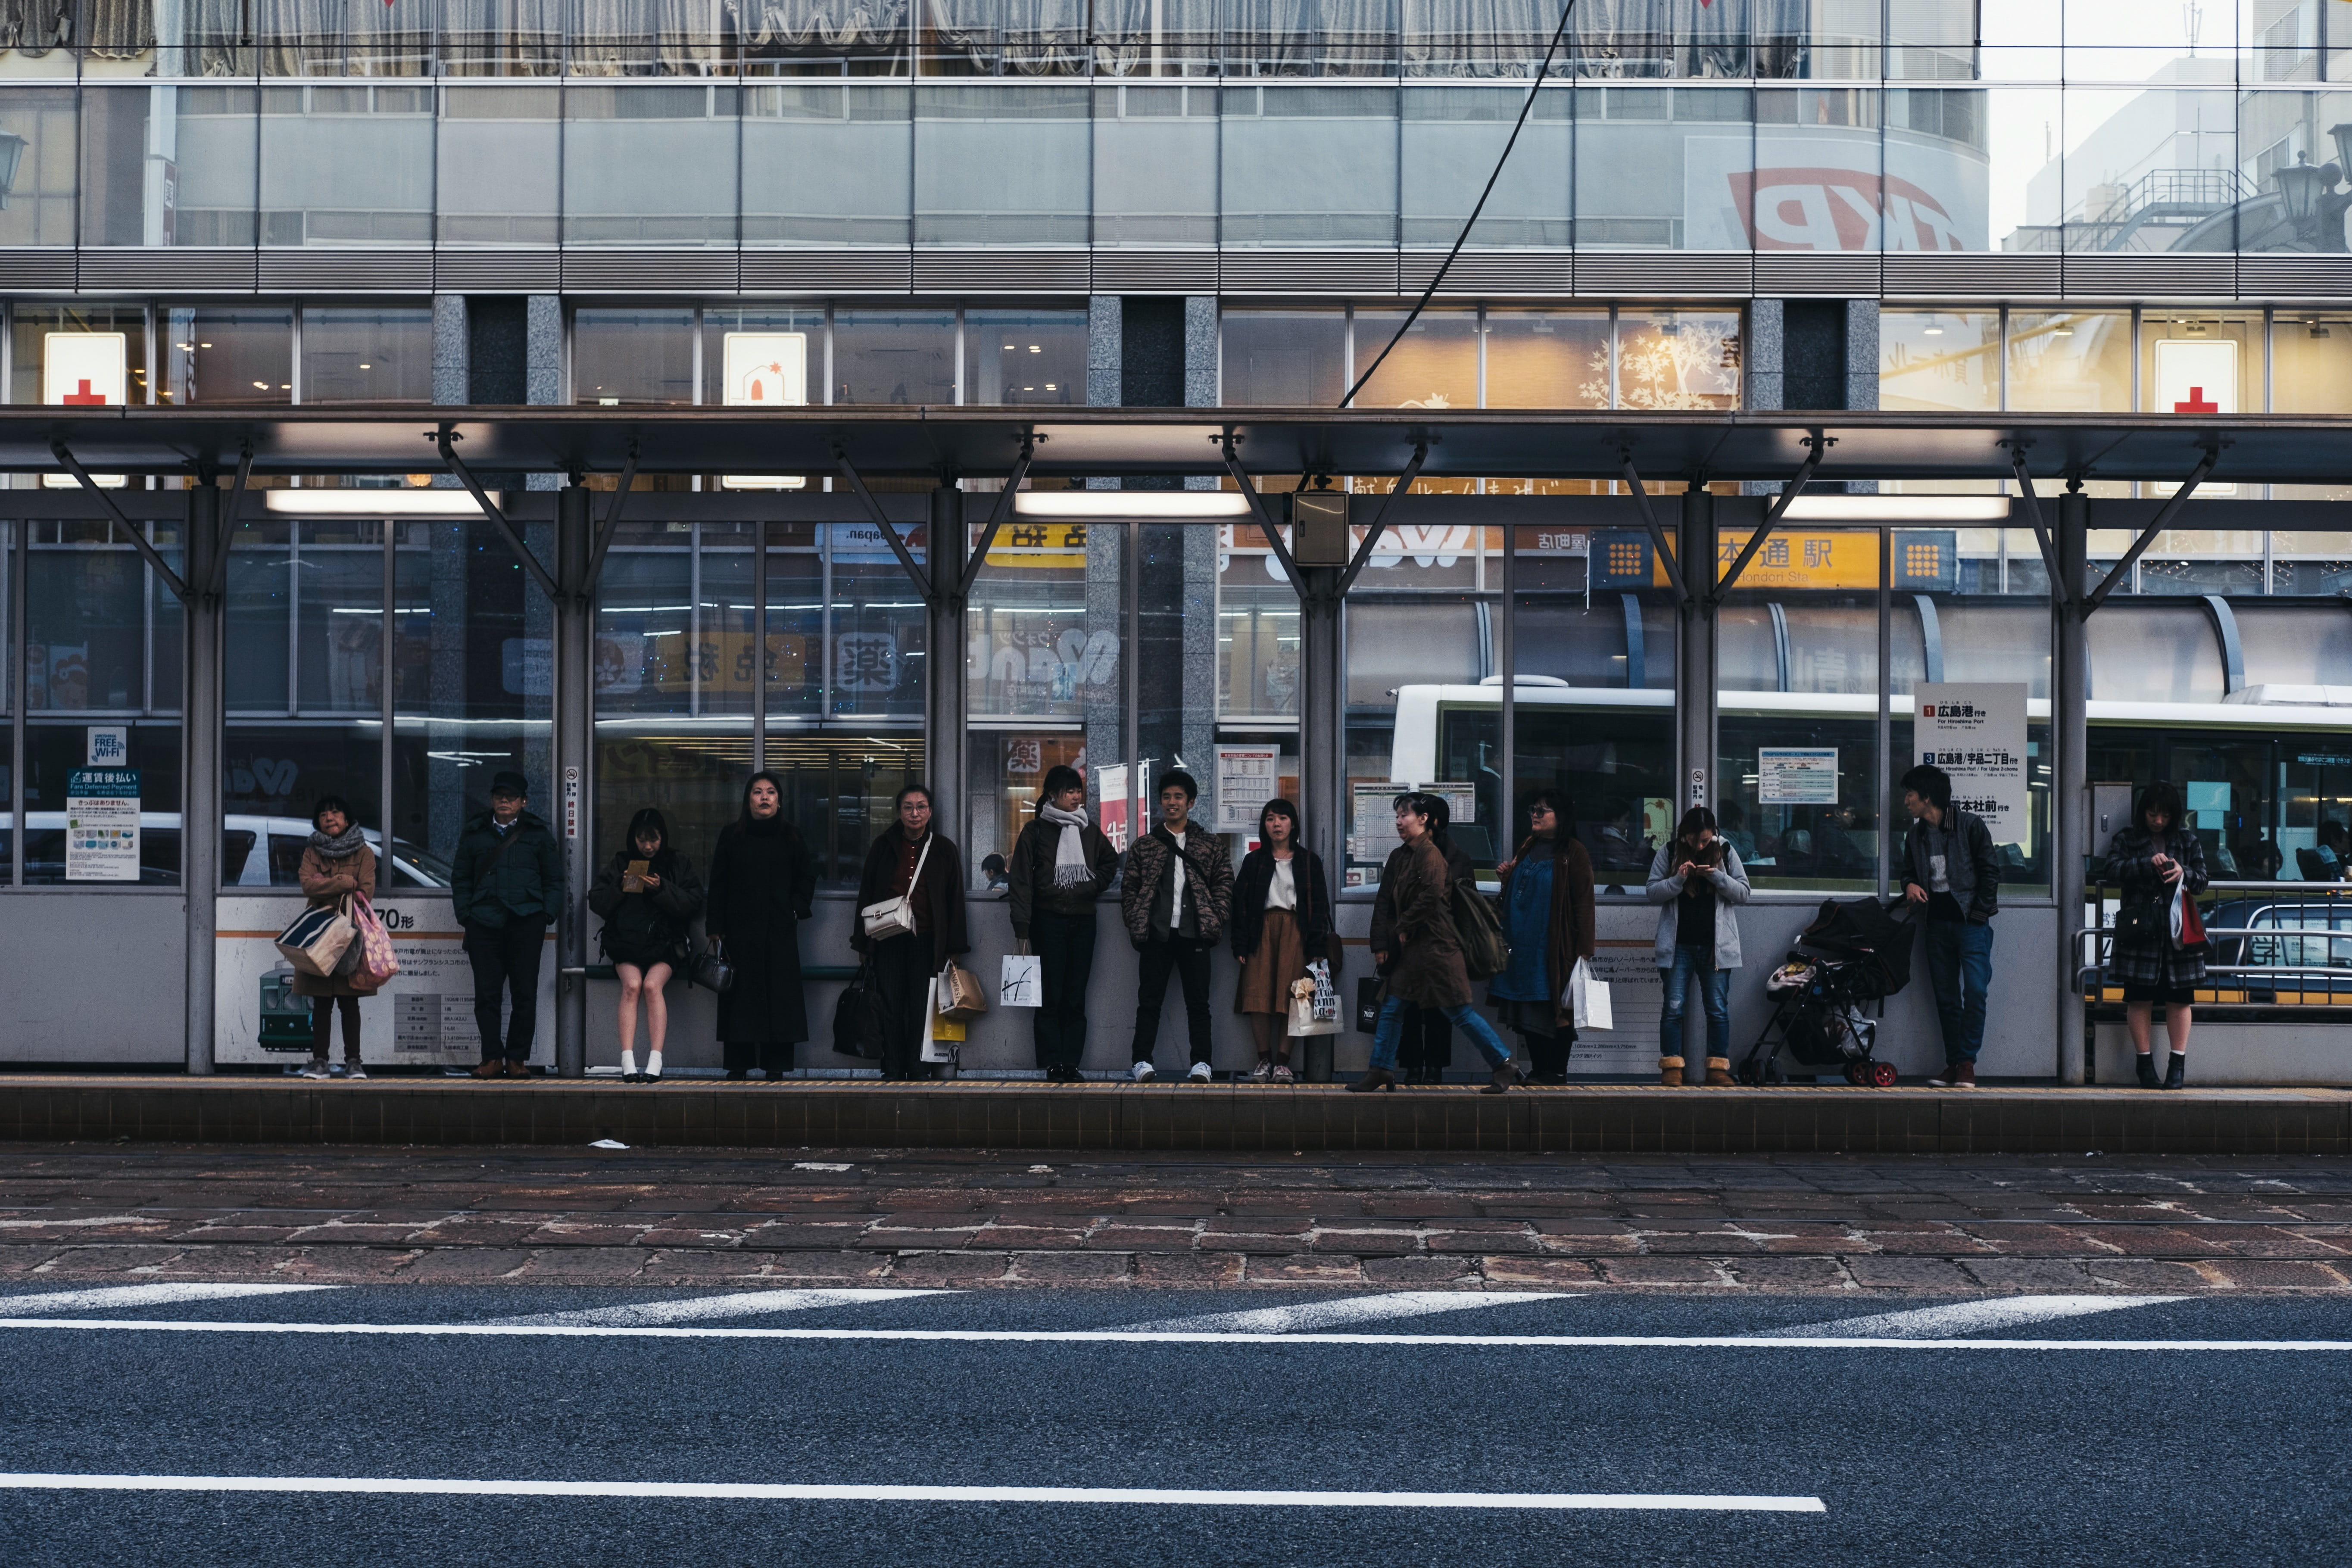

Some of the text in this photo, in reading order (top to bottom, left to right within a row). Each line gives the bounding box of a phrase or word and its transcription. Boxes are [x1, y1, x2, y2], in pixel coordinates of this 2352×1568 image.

[1718, 537, 1833, 569] 本通駅
[1738, 571, 1784, 582] Hondori
[1926, 707, 1931, 715] 1
[1938, 705, 1986, 717] 広島港行き
[95, 738, 117, 747] FREE
[1926, 754, 1932, 763] 3
[82, 772, 136, 783] 運賃後払い
